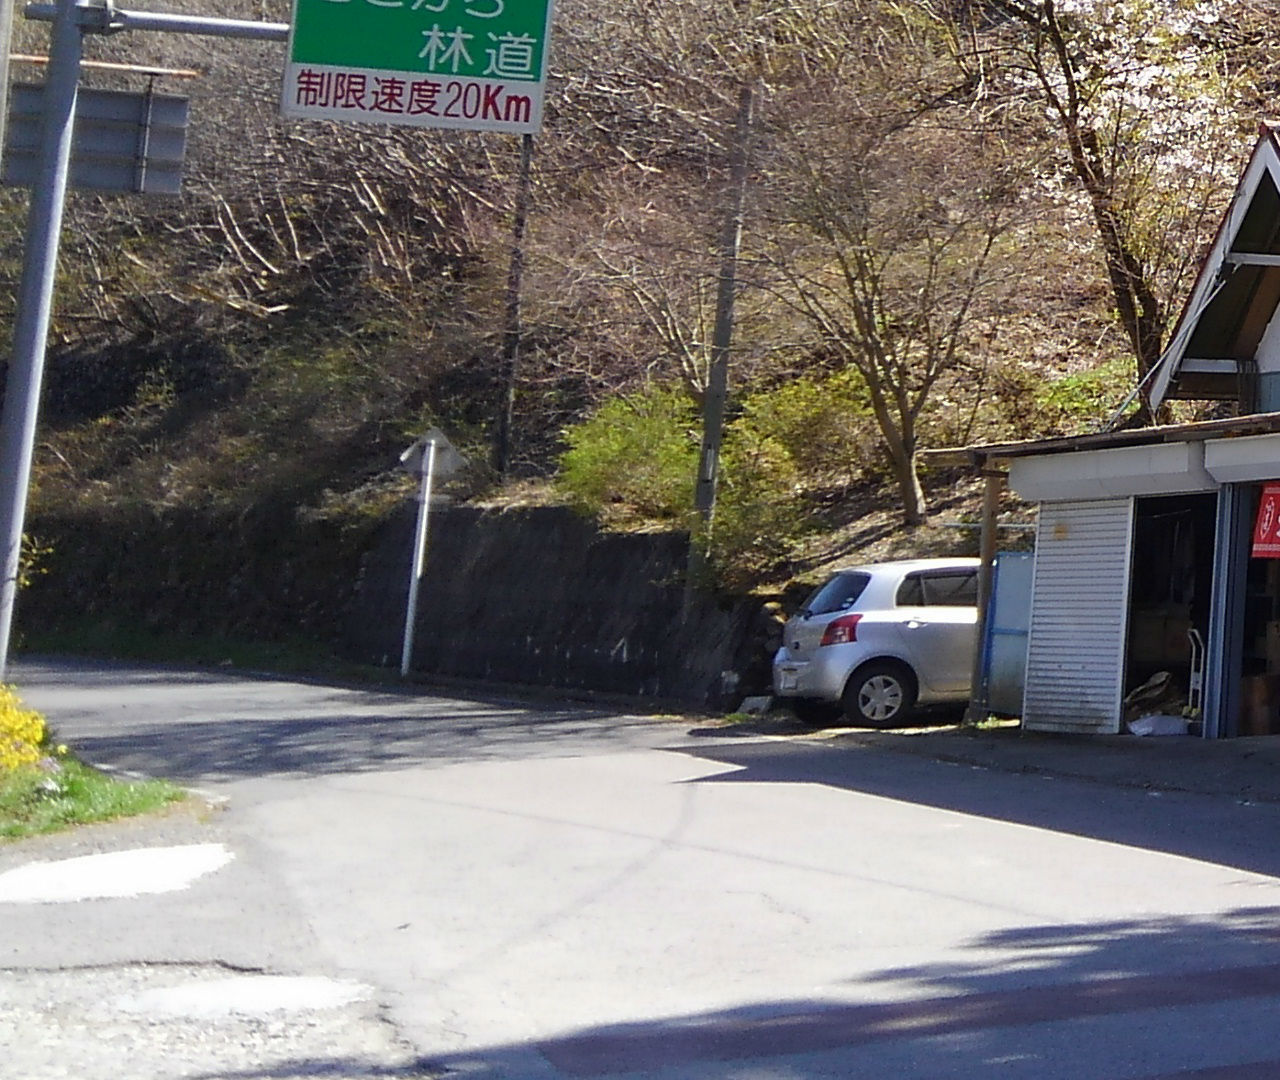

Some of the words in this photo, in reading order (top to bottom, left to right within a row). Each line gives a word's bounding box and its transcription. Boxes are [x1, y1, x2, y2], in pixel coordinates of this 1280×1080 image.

[418, 24, 537, 81] 林道
[295, 69, 532, 124] 制限速度20Km
